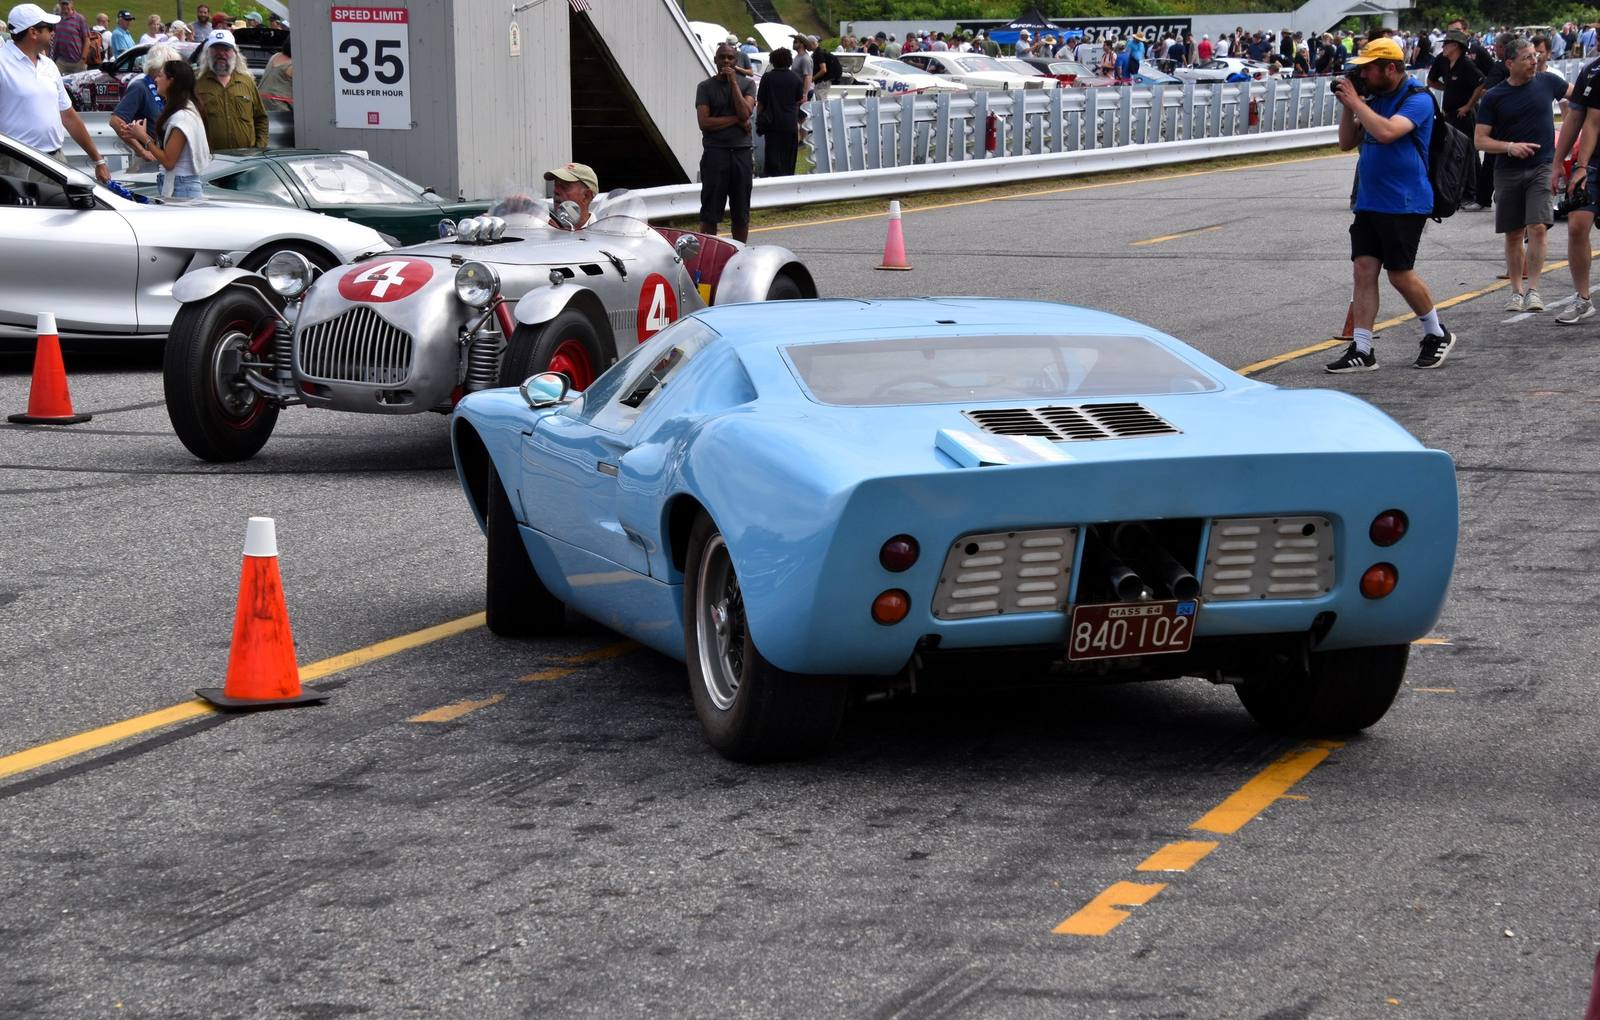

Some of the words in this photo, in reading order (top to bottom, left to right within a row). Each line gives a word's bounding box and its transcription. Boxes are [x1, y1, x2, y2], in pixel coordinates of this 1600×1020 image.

[335, 10, 371, 20] SPEED
[372, 10, 404, 21] LIMIT
[339, 38, 404, 84] 35
[887, 80, 910, 92] Jet
[366, 89, 381, 97] PER
[352, 260, 412, 298] 4
[646, 283, 670, 331] 4
[1110, 607, 1141, 616] MASS
[1146, 606, 1161, 615] 64
